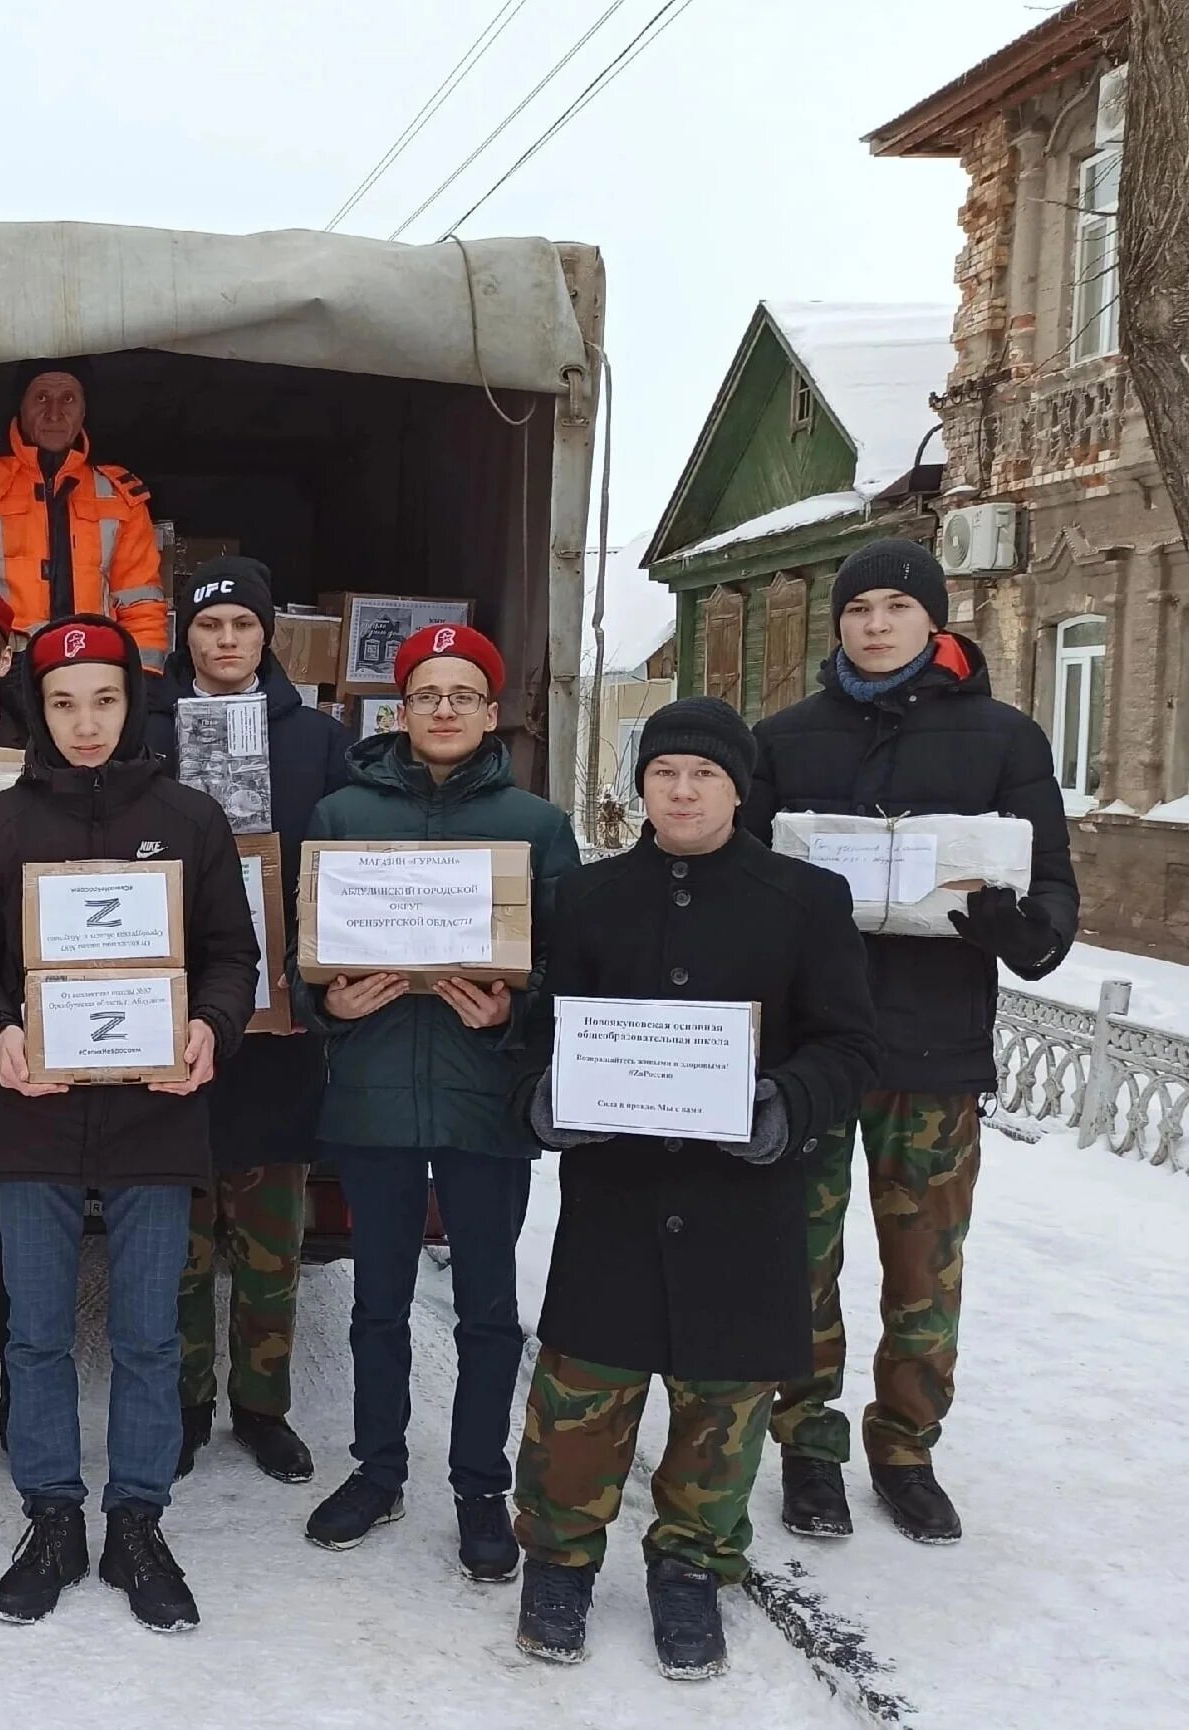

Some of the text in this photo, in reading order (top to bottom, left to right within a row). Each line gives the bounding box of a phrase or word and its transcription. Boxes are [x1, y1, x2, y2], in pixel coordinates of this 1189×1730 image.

[194, 580, 235, 603] UFC
[140, 841, 161, 850] NIKE
[359, 857, 405, 866] МАГАЗИН
[341, 884, 478, 896] АБДУЛИНСКИЙ ГОРОДСКОЙ
[389, 902, 422, 910] ОКРУГ
[85, 898, 122, 927] Z
[346, 917, 472, 928] ОРЕНБУРГСКОЙ ОБЛАСТИ
[90, 1011, 128, 1042] Z
[673, 1023, 723, 1032] основная
[577, 1030, 729, 1046] общеобразовательная школа
